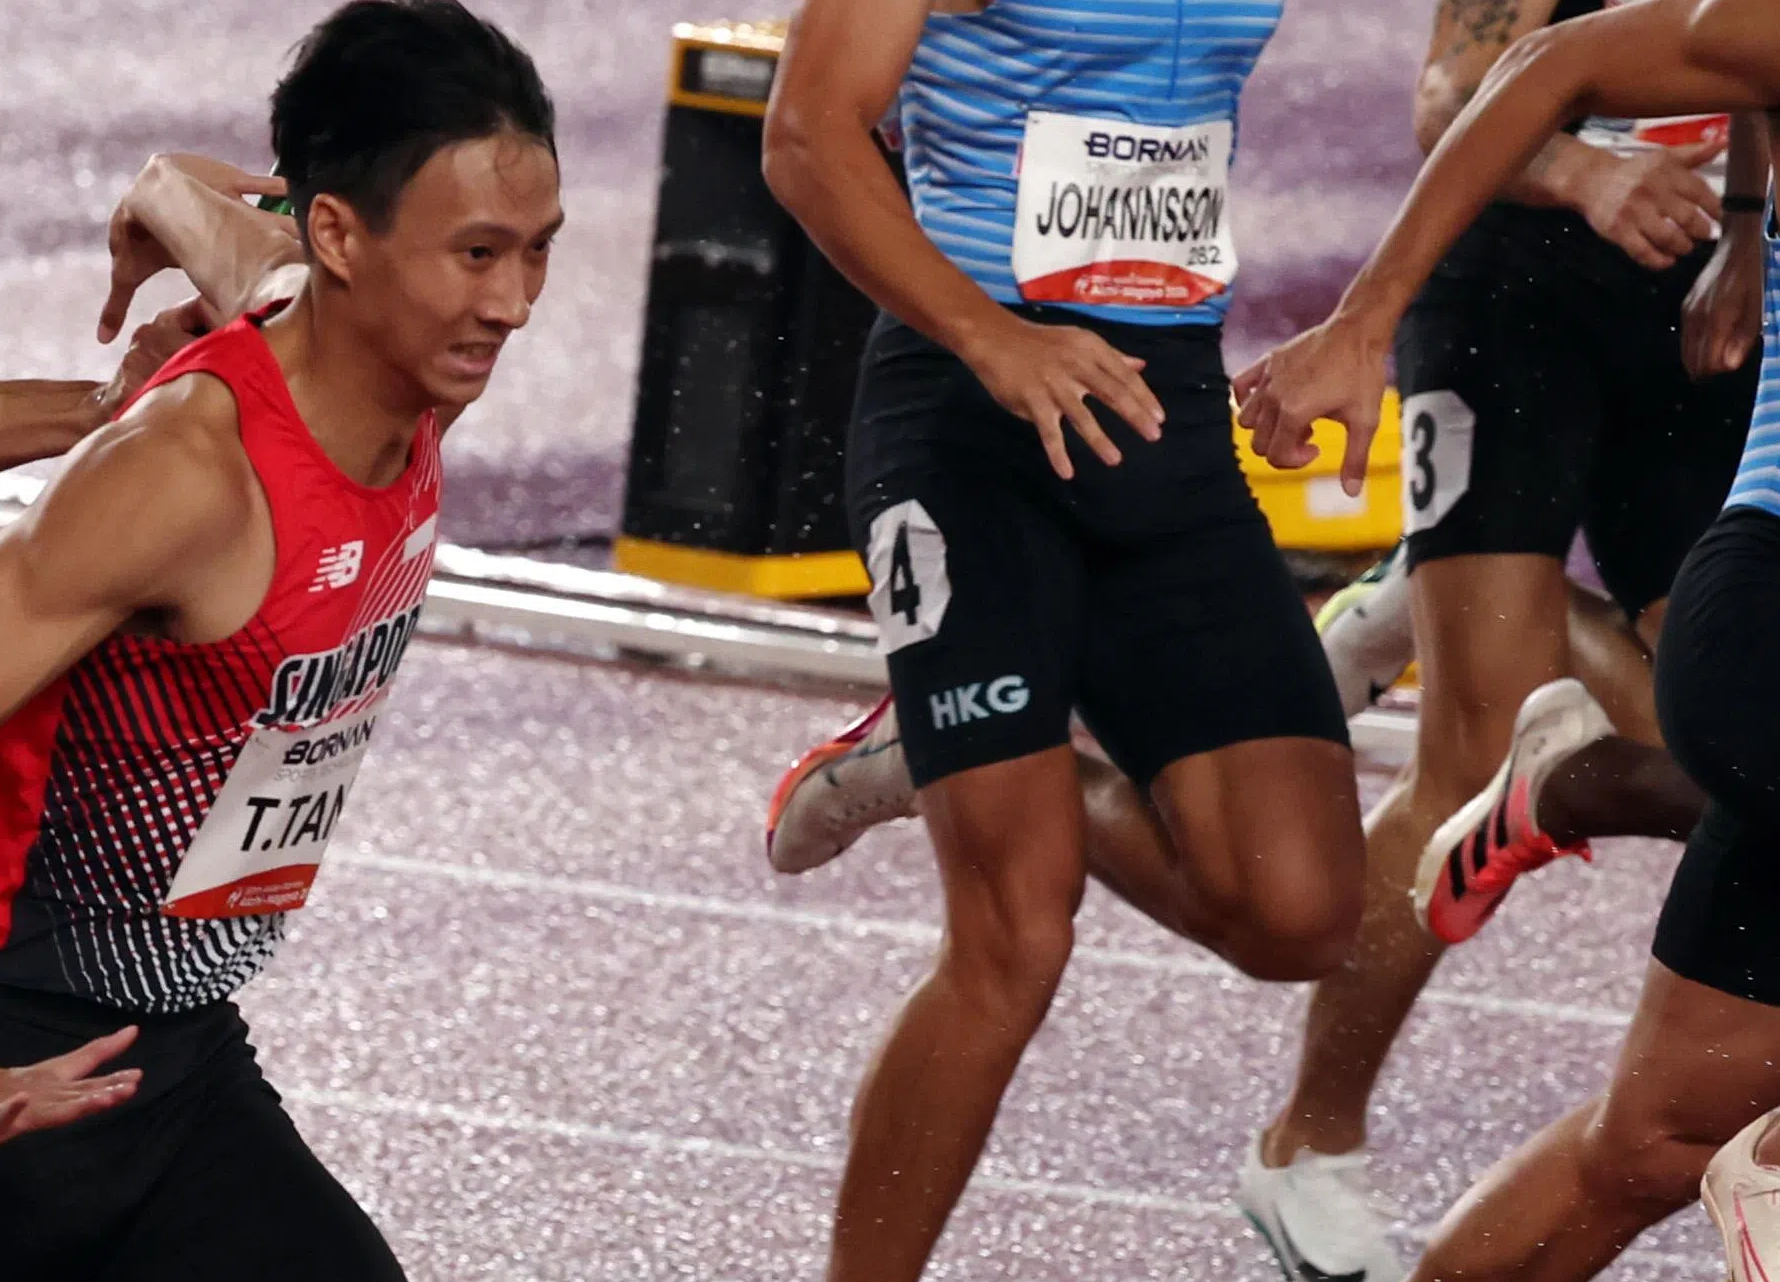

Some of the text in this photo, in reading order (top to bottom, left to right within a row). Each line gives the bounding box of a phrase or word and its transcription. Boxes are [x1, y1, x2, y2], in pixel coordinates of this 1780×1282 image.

[1084, 132, 1208, 162] BORNAN
[1036, 182, 1223, 243] JOHANNSSON
[1410, 412, 1436, 511] 3
[890, 520, 921, 626] 4
[929, 674, 1031, 731] HKG
